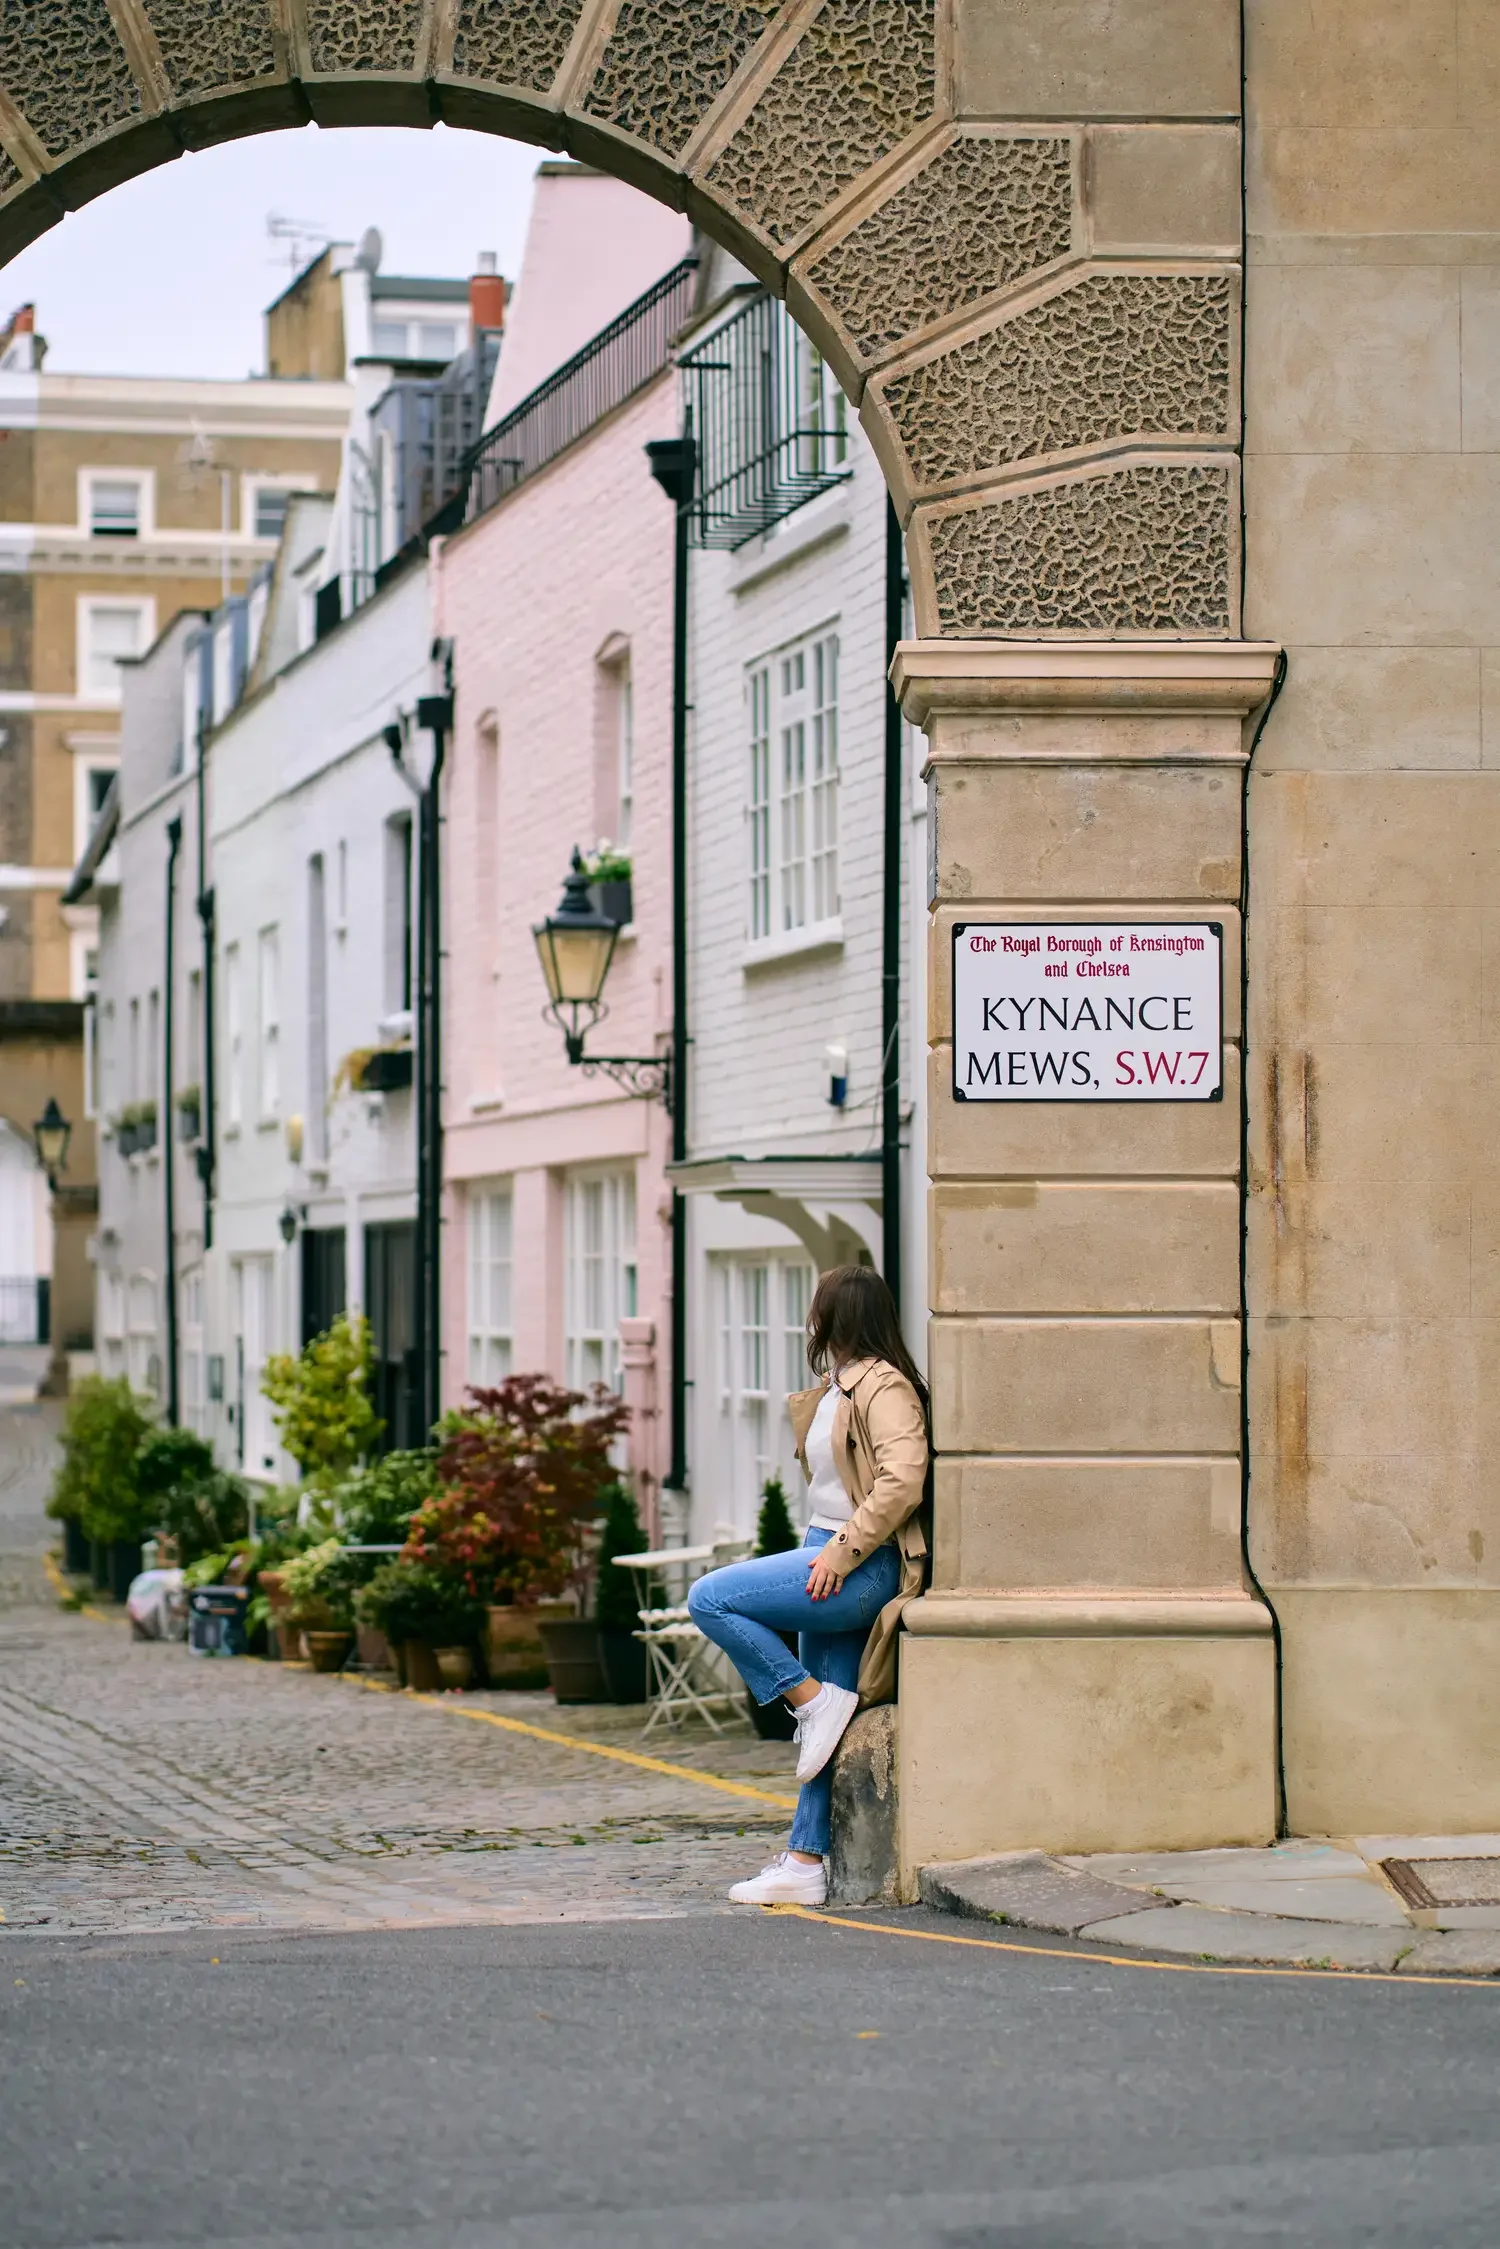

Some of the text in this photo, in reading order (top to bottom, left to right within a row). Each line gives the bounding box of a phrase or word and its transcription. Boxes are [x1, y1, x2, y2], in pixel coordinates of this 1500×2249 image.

[970, 933, 1205, 957] The Royal Borough of Kensington
[1044, 960, 1130, 978] and Chelsea
[982, 996, 1194, 1031] KYNANCE
[966, 1050, 1210, 1090] MEWS, S.W.7
